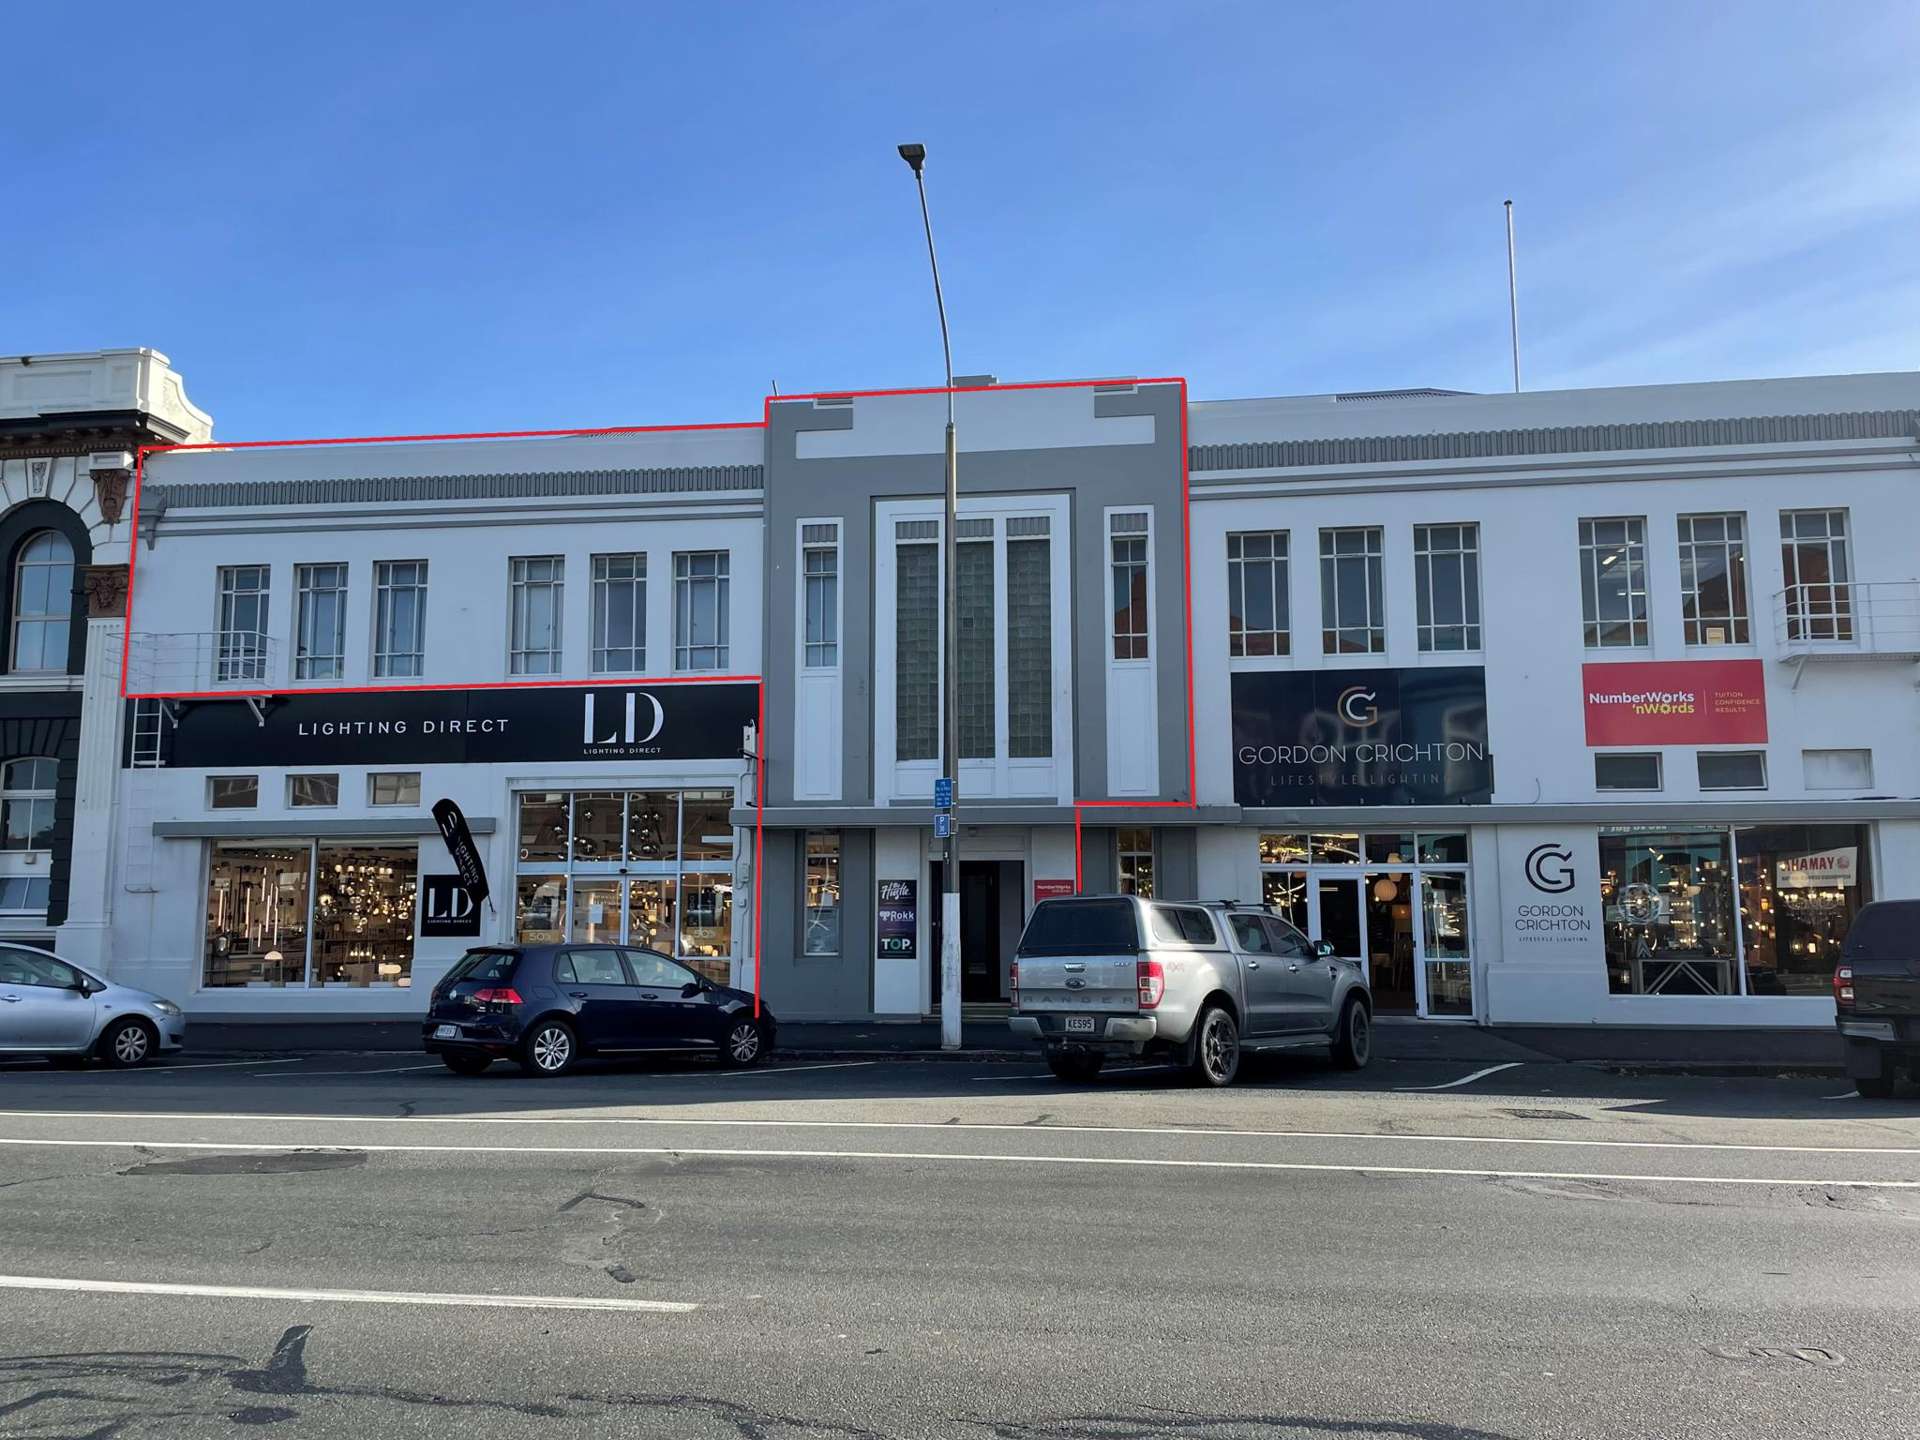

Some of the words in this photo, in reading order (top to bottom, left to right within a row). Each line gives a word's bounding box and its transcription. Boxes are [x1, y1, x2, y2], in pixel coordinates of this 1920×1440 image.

[1589, 691, 1695, 704] NumberWorks
[583, 692, 664, 744] LD
[299, 721, 408, 735] LIGHTING
[423, 719, 509, 733] DIRECT
[1239, 745, 1346, 765] GORDON
[1355, 742, 1483, 762] CRICHTON
[1271, 774, 1360, 785] LIFESTYLE
[428, 888, 473, 917] LD
[891, 911, 914, 921] Rokk
[1518, 905, 1584, 916] GORDON
[1515, 919, 1591, 930] CRICHTON
[1067, 1016, 1092, 1029] KES95
